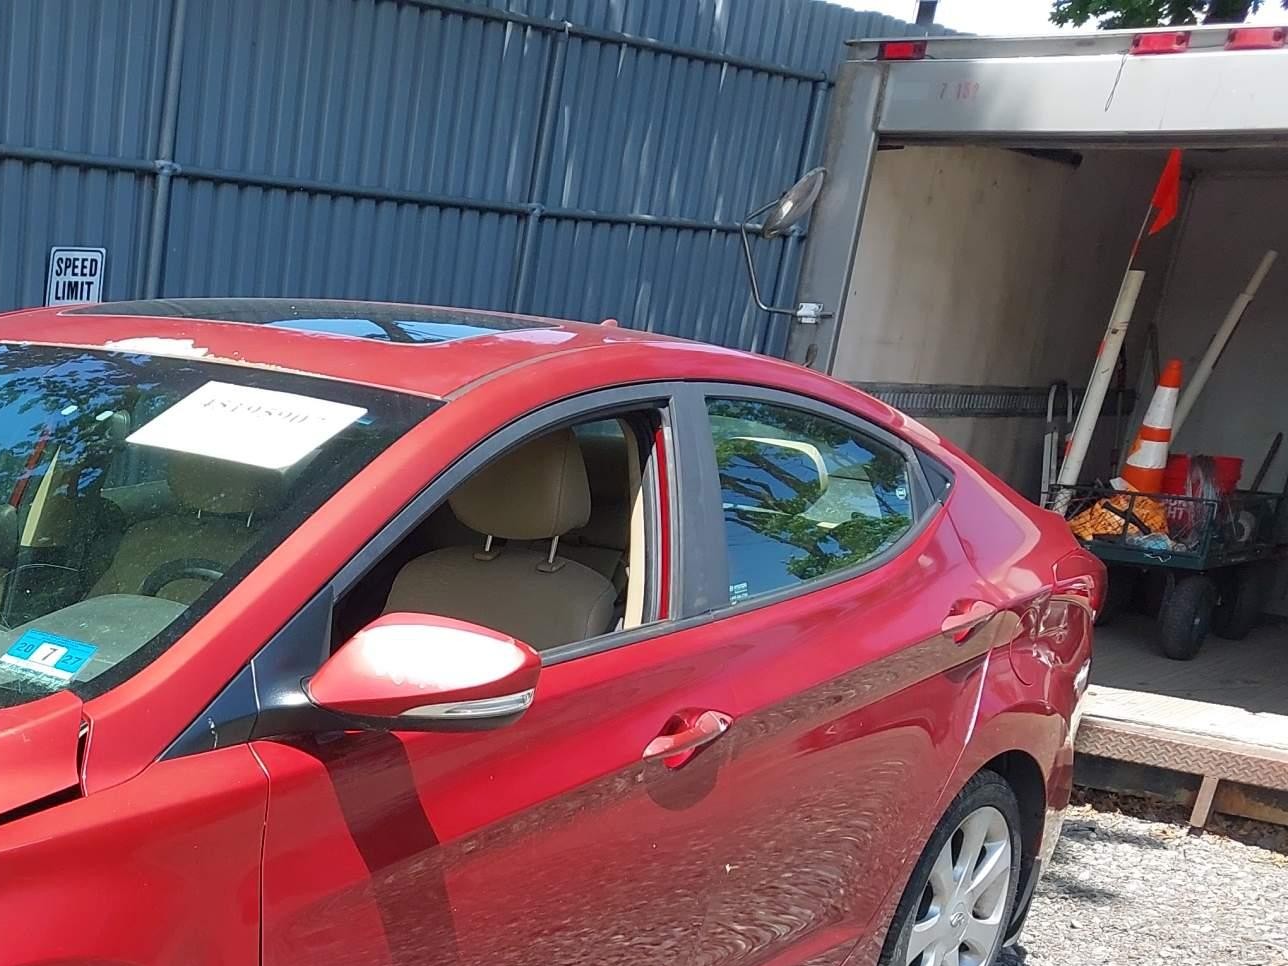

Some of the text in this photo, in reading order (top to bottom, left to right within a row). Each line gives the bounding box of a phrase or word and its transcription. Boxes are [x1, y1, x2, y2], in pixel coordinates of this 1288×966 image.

[55, 257, 98, 277] SPEED
[54, 280, 94, 301] LIMIT
[16, 642, 81, 666] 20 7 27
